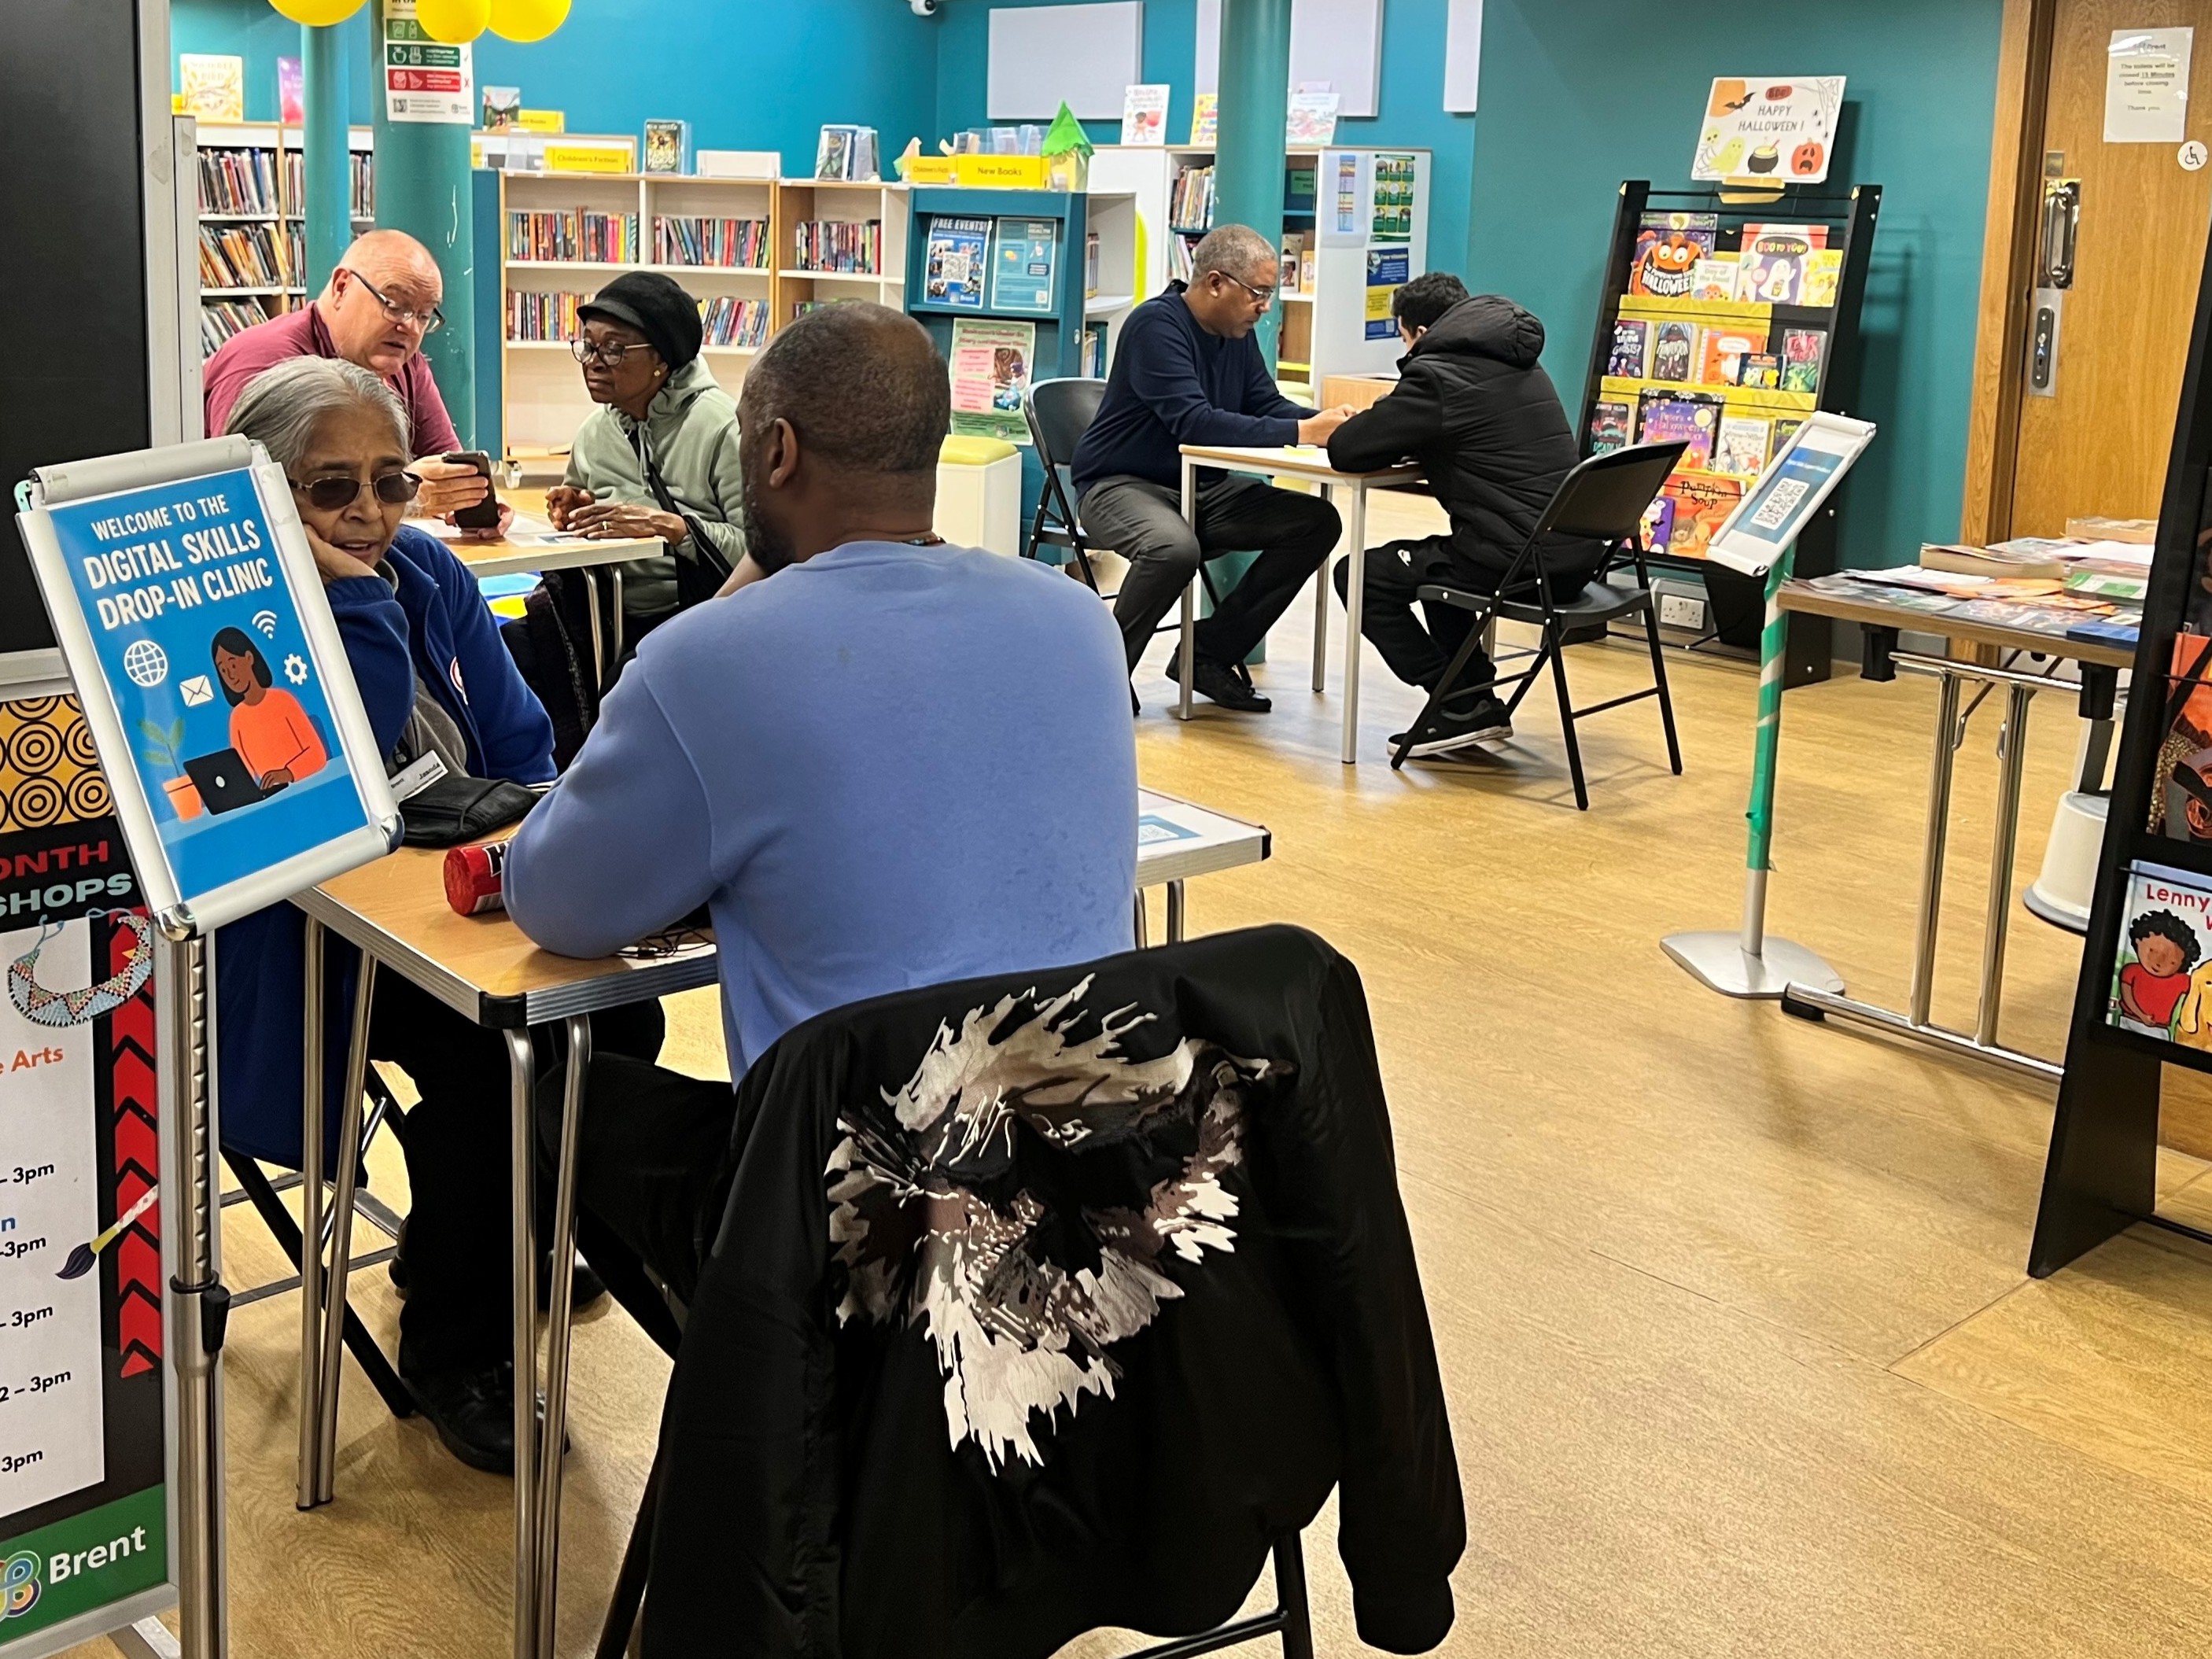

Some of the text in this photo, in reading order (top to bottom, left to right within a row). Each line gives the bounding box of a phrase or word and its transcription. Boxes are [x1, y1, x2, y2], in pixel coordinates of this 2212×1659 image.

[1757, 105, 1792, 116] HAPPY
[1738, 120, 1797, 131] HALLOWEEN
[933, 218, 953, 229] FREE
[1757, 241, 1776, 253] BOO
[1642, 270, 1690, 296] HALLOWEE
[1680, 481, 1727, 498] Pumpkin
[90, 494, 230, 541] WELCOME TO THE
[83, 519, 261, 589] DIGITAL SKILLS
[96, 558, 273, 630] DROP-IN CLINIC
[0, 873, 132, 917] HOPS
[2146, 883, 2210, 913] Lenny
[11, 1047, 64, 1072] Arts
[13, 1163, 54, 1185] 3pm
[11, 1305, 53, 1329] 3pm
[30, 1370, 72, 1393] 3pm
[1, 1449, 43, 1473] 3pm
[50, 1525, 146, 1584] Brent
